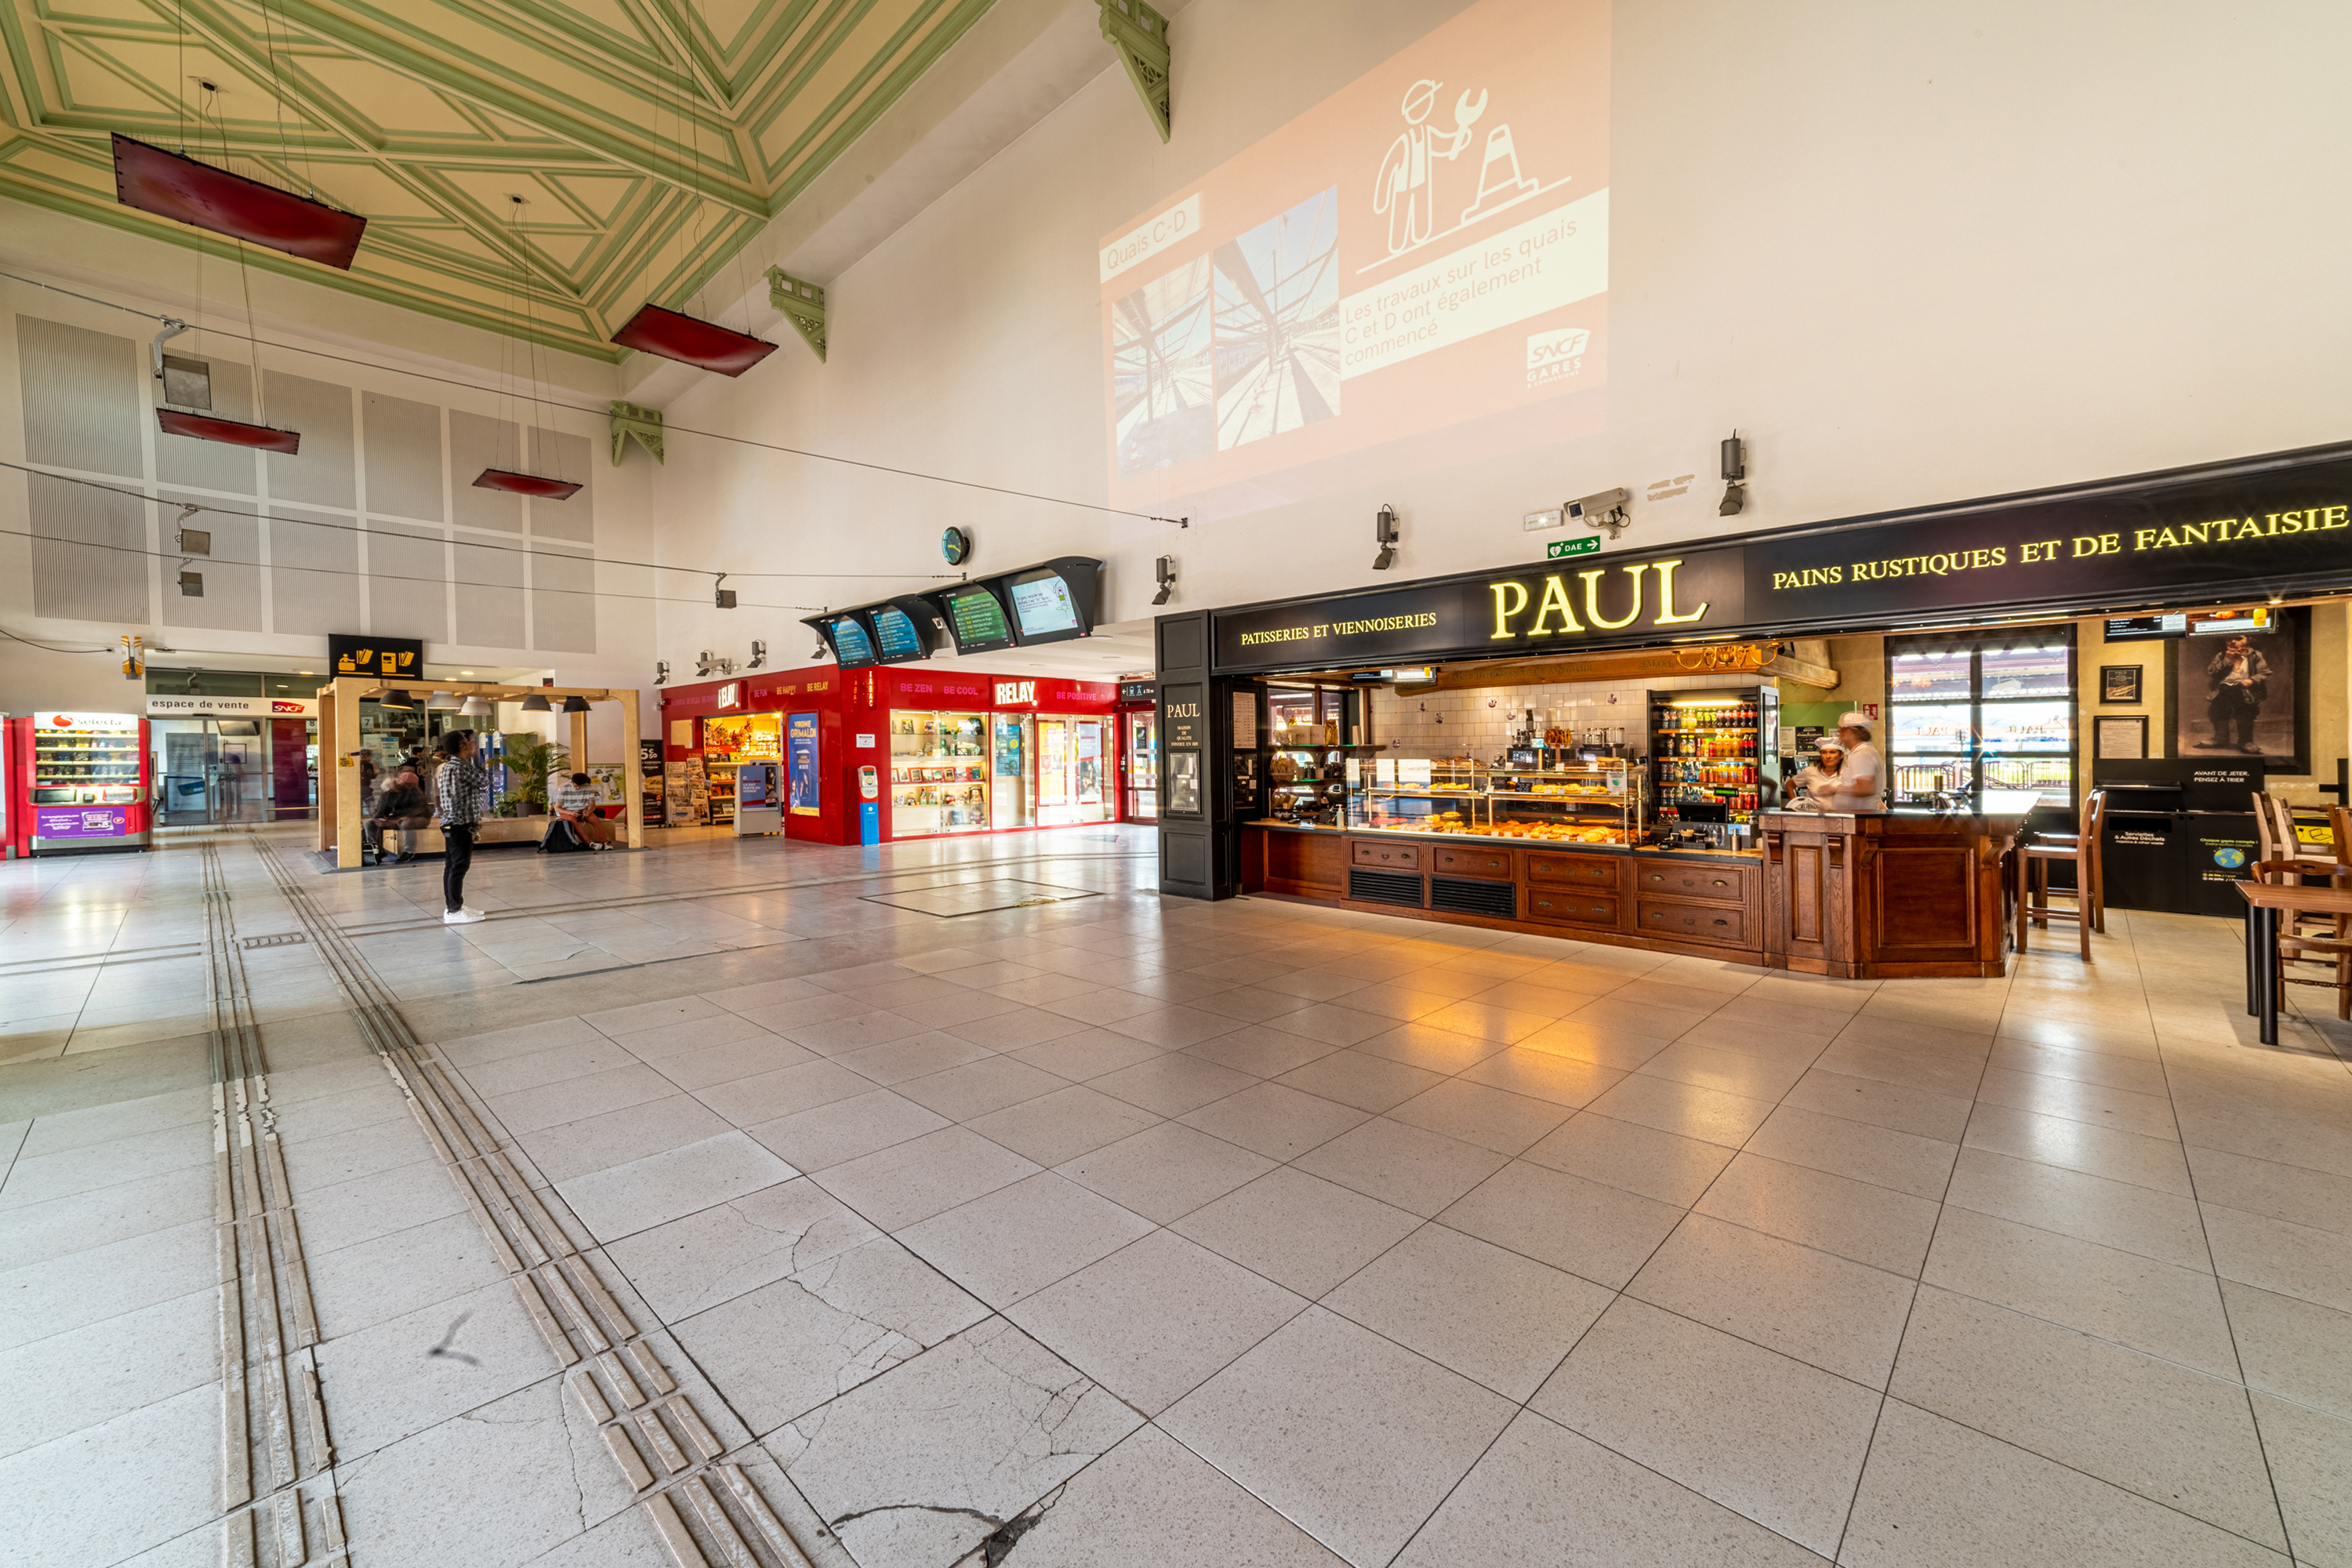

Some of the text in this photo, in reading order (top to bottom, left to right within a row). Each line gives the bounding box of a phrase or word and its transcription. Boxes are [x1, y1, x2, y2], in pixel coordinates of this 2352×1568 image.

[1106, 210, 1186, 270] Quais C-D
[1345, 217, 1577, 325] Les travaux sur les quais
[1345, 257, 1543, 344] C et D ont également
[1345, 321, 1438, 365] commencé
[1530, 333, 1584, 364] SNCF
[1526, 358, 1581, 382] GARES
[1534, 370, 1579, 387] CONNEXIONS
[1565, 543, 1582, 552] DAE
[1773, 505, 2349, 590] PAINS RUSTIQUES ET DE FANTAISIE
[1490, 560, 1709, 639] PAUL
[1241, 612, 1436, 645] PATISSERIES ET VIENNOISERIES
[776, 685, 796, 695] BE HAPPY
[807, 681, 828, 692] BE RELAY
[901, 683, 932, 693] BE ZEN
[944, 686, 978, 695] BE COOL
[995, 681, 1035, 705] RELAY
[1057, 691, 1097, 701] BE POSITIVE
[152, 700, 194, 709] espace
[1167, 703, 1200, 718] PAUL
[790, 728, 816, 738] GRIMALDI
